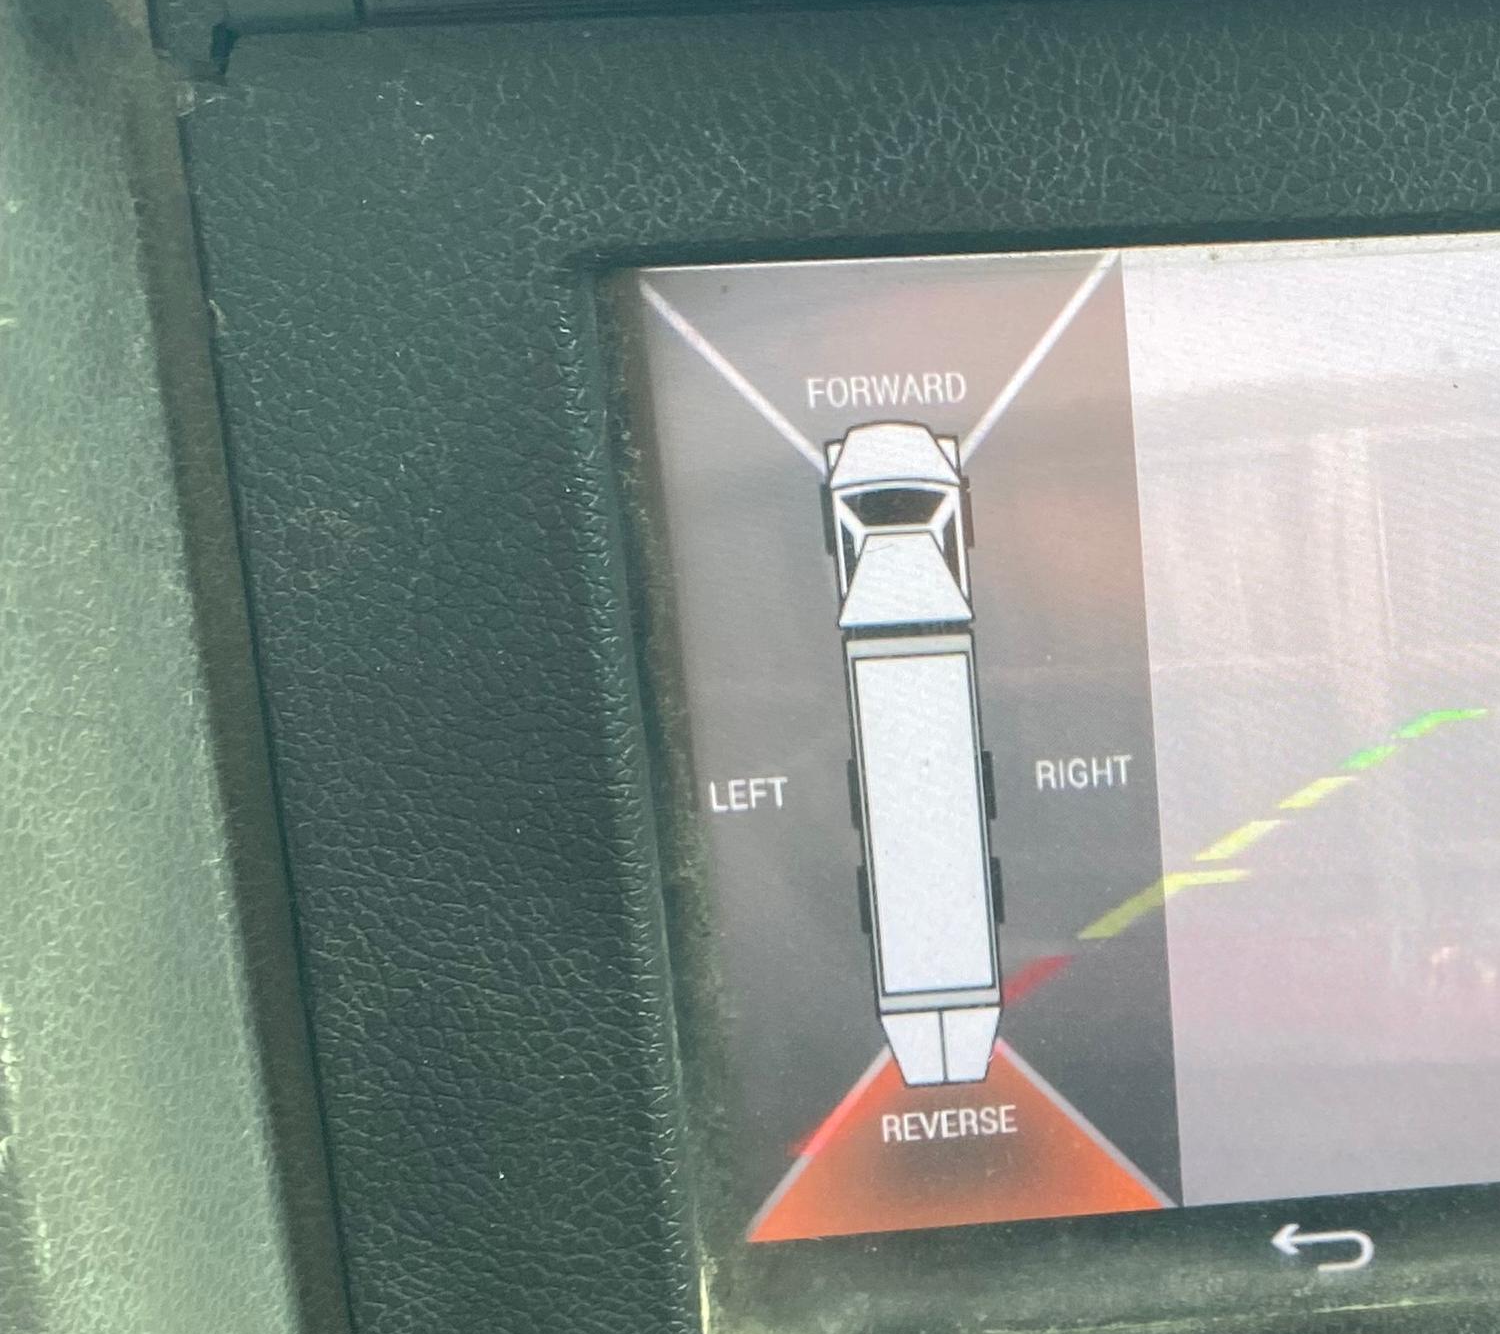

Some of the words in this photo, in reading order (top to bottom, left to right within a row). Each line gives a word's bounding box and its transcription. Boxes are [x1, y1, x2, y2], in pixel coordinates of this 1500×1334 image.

[806, 371, 967, 410] FORWARD
[1035, 753, 1132, 790] RIGHT
[709, 776, 788, 813] LEFT
[881, 1104, 1018, 1144] REVERSE
